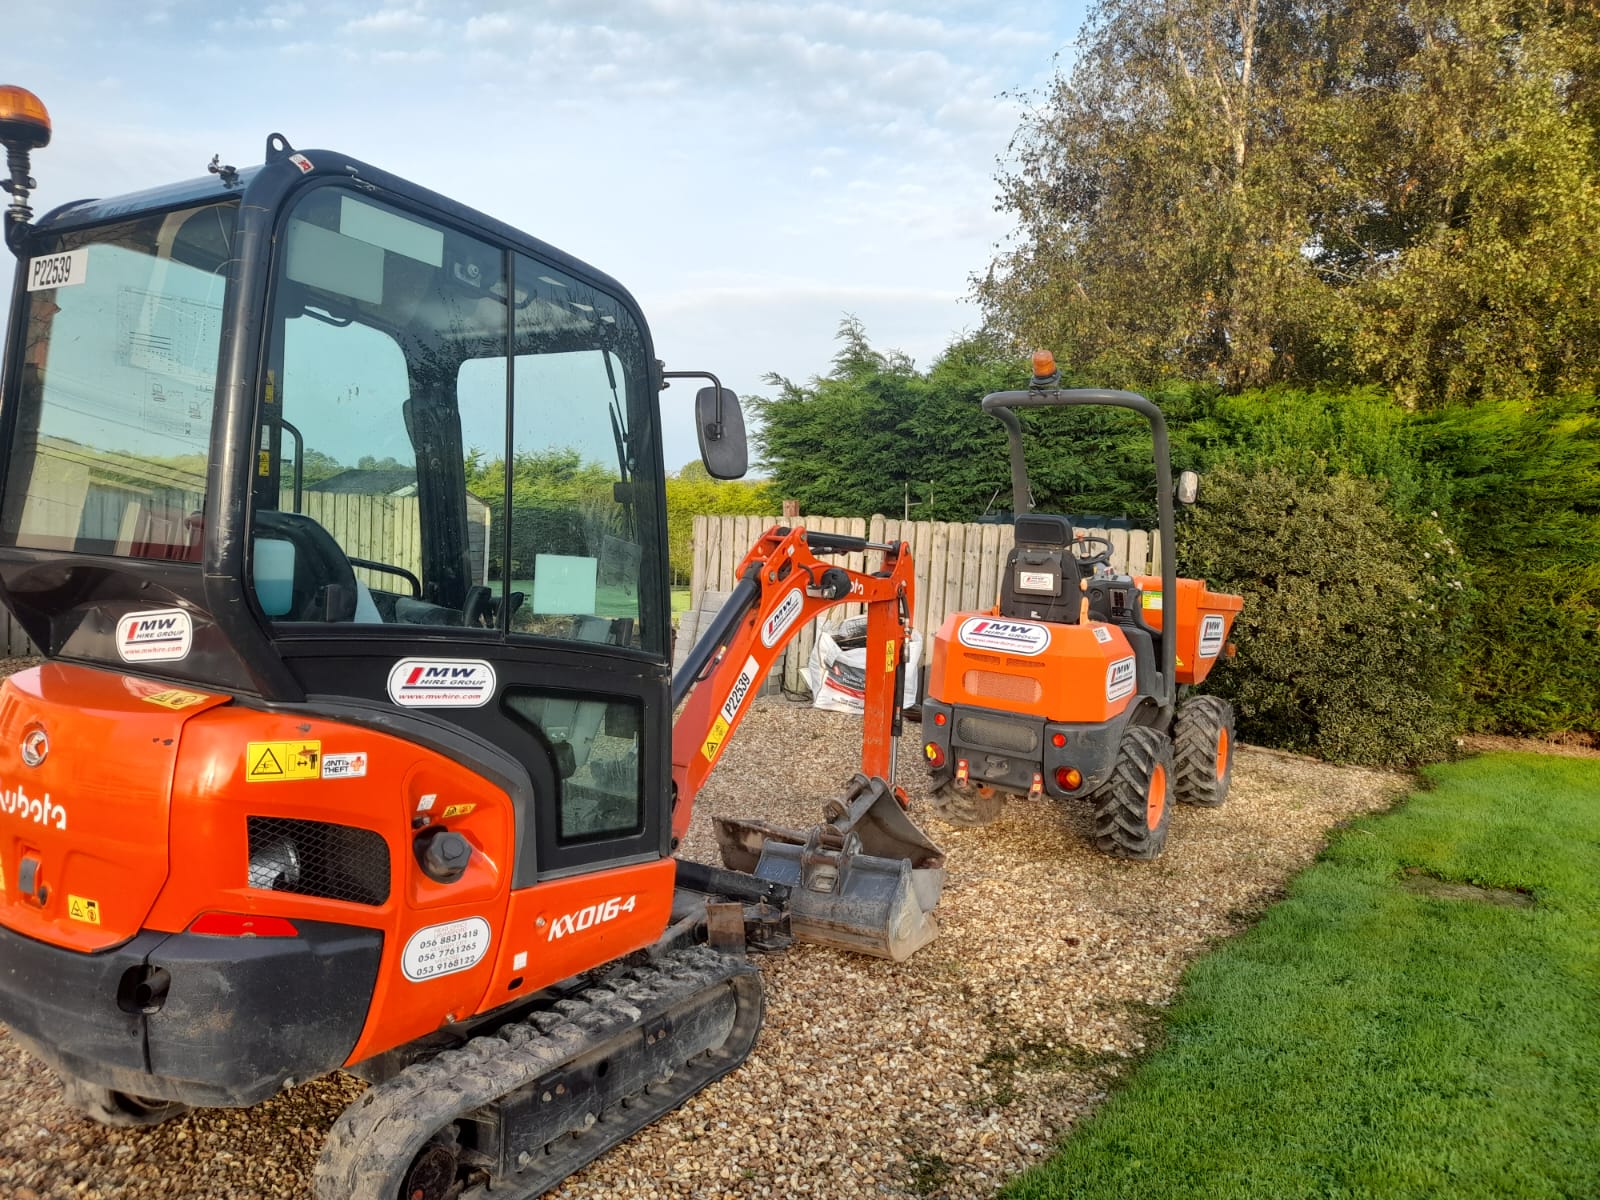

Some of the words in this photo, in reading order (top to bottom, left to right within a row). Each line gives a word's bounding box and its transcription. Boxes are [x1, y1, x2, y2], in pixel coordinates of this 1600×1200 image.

[33, 255, 72, 287] P22539
[774, 597, 793, 622] MW
[140, 618, 177, 631] MW
[156, 630, 185, 638] GROUP
[989, 623, 1033, 634] MW
[425, 667, 477, 678] MW
[1116, 662, 1131, 675] MW
[724, 672, 751, 718] P22539
[547, 894, 637, 942] KX016-4
[419, 941, 438, 950] 056
[440, 929, 479, 945] 8831418
[417, 953, 436, 963] 056
[439, 942, 477, 958] 7761265
[416, 965, 434, 977] 053
[436, 955, 476, 971] 9168122
